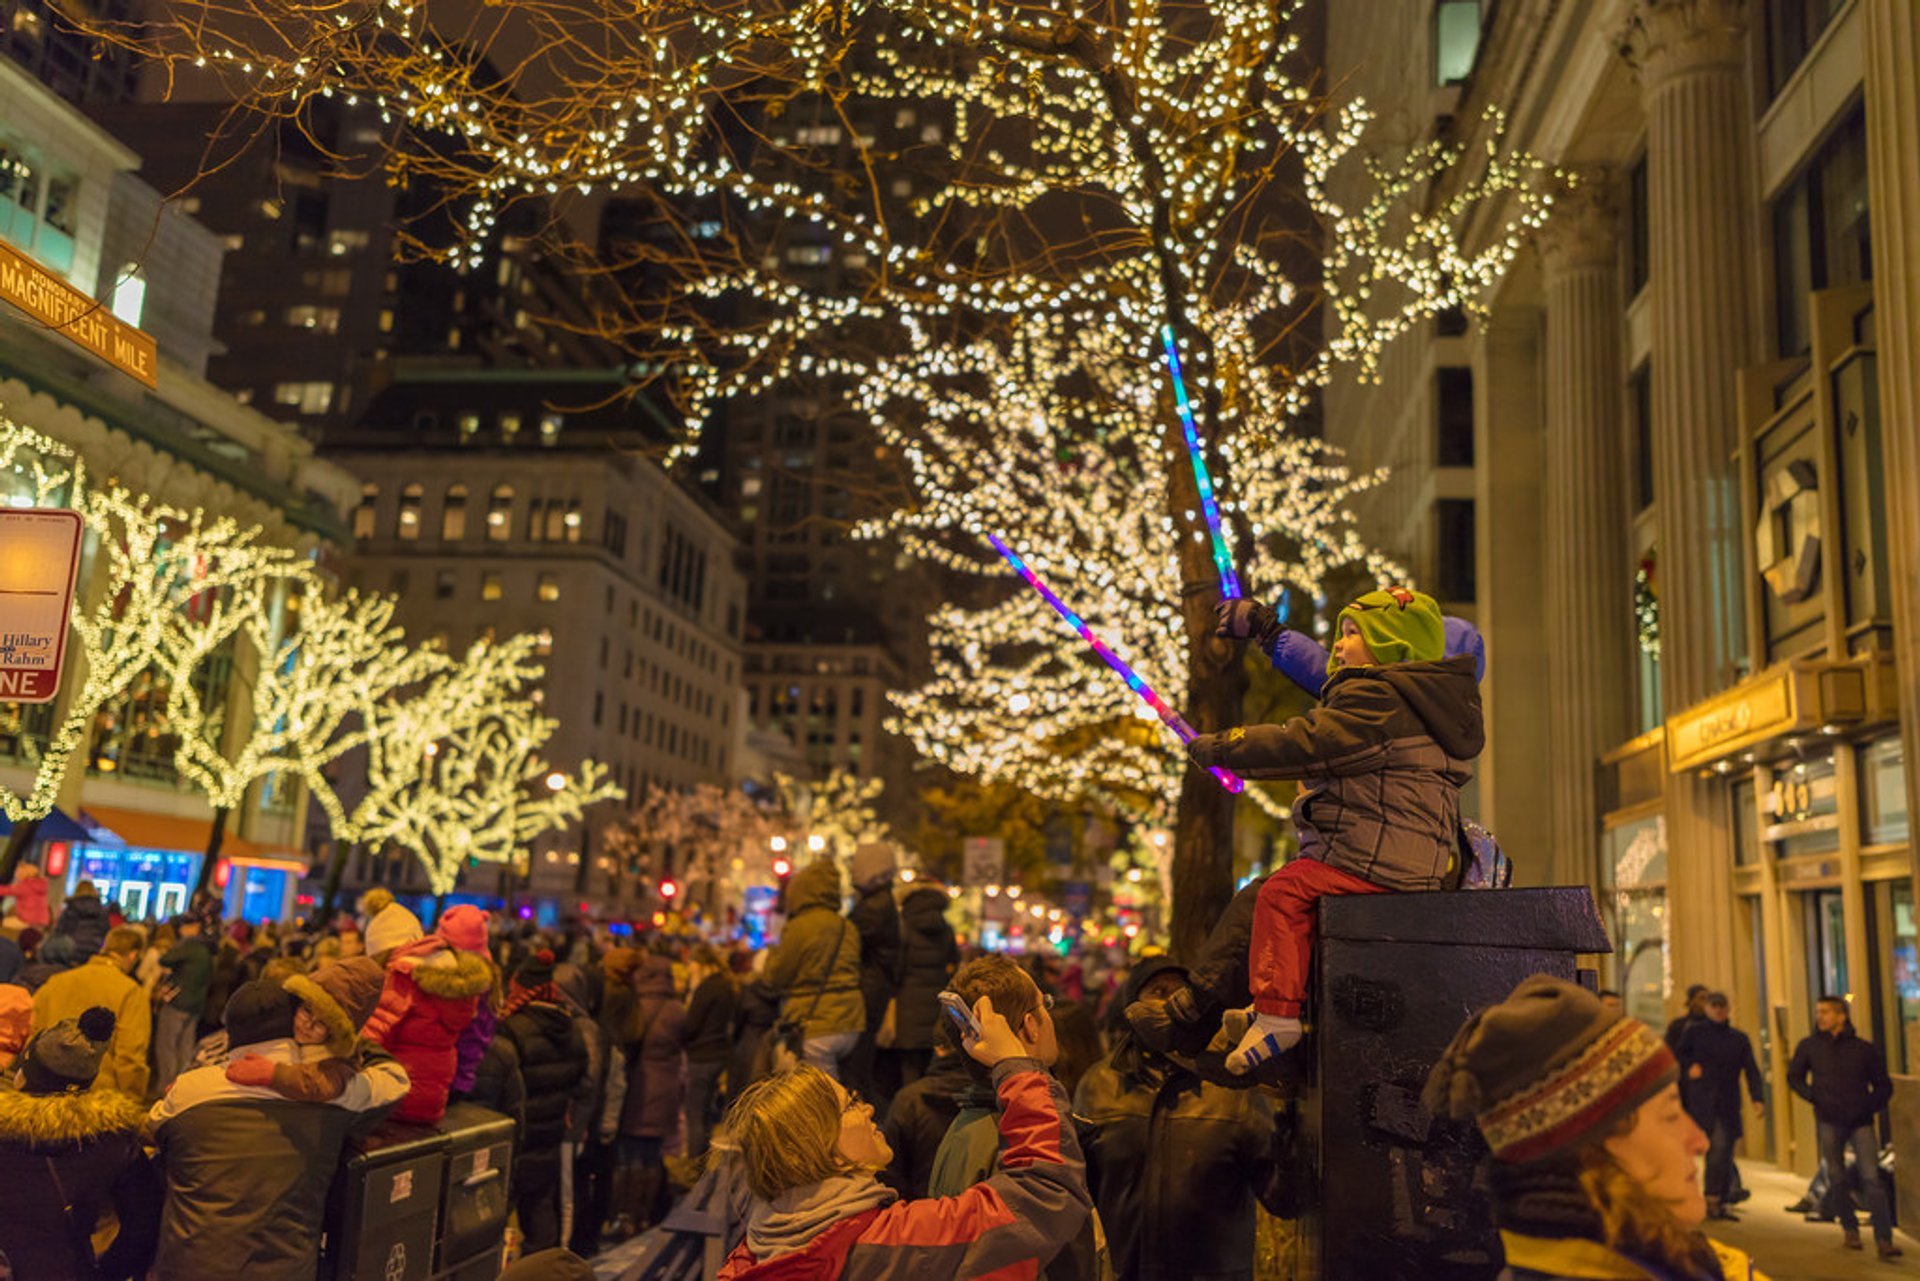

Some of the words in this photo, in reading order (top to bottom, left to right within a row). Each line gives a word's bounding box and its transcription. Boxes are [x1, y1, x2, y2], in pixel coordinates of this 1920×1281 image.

[1, 262, 108, 351] MAGNIFICENT
[115, 335, 148, 376] MILE
[3, 634, 52, 650] Hillary
[3, 652, 45, 664] Rahm
